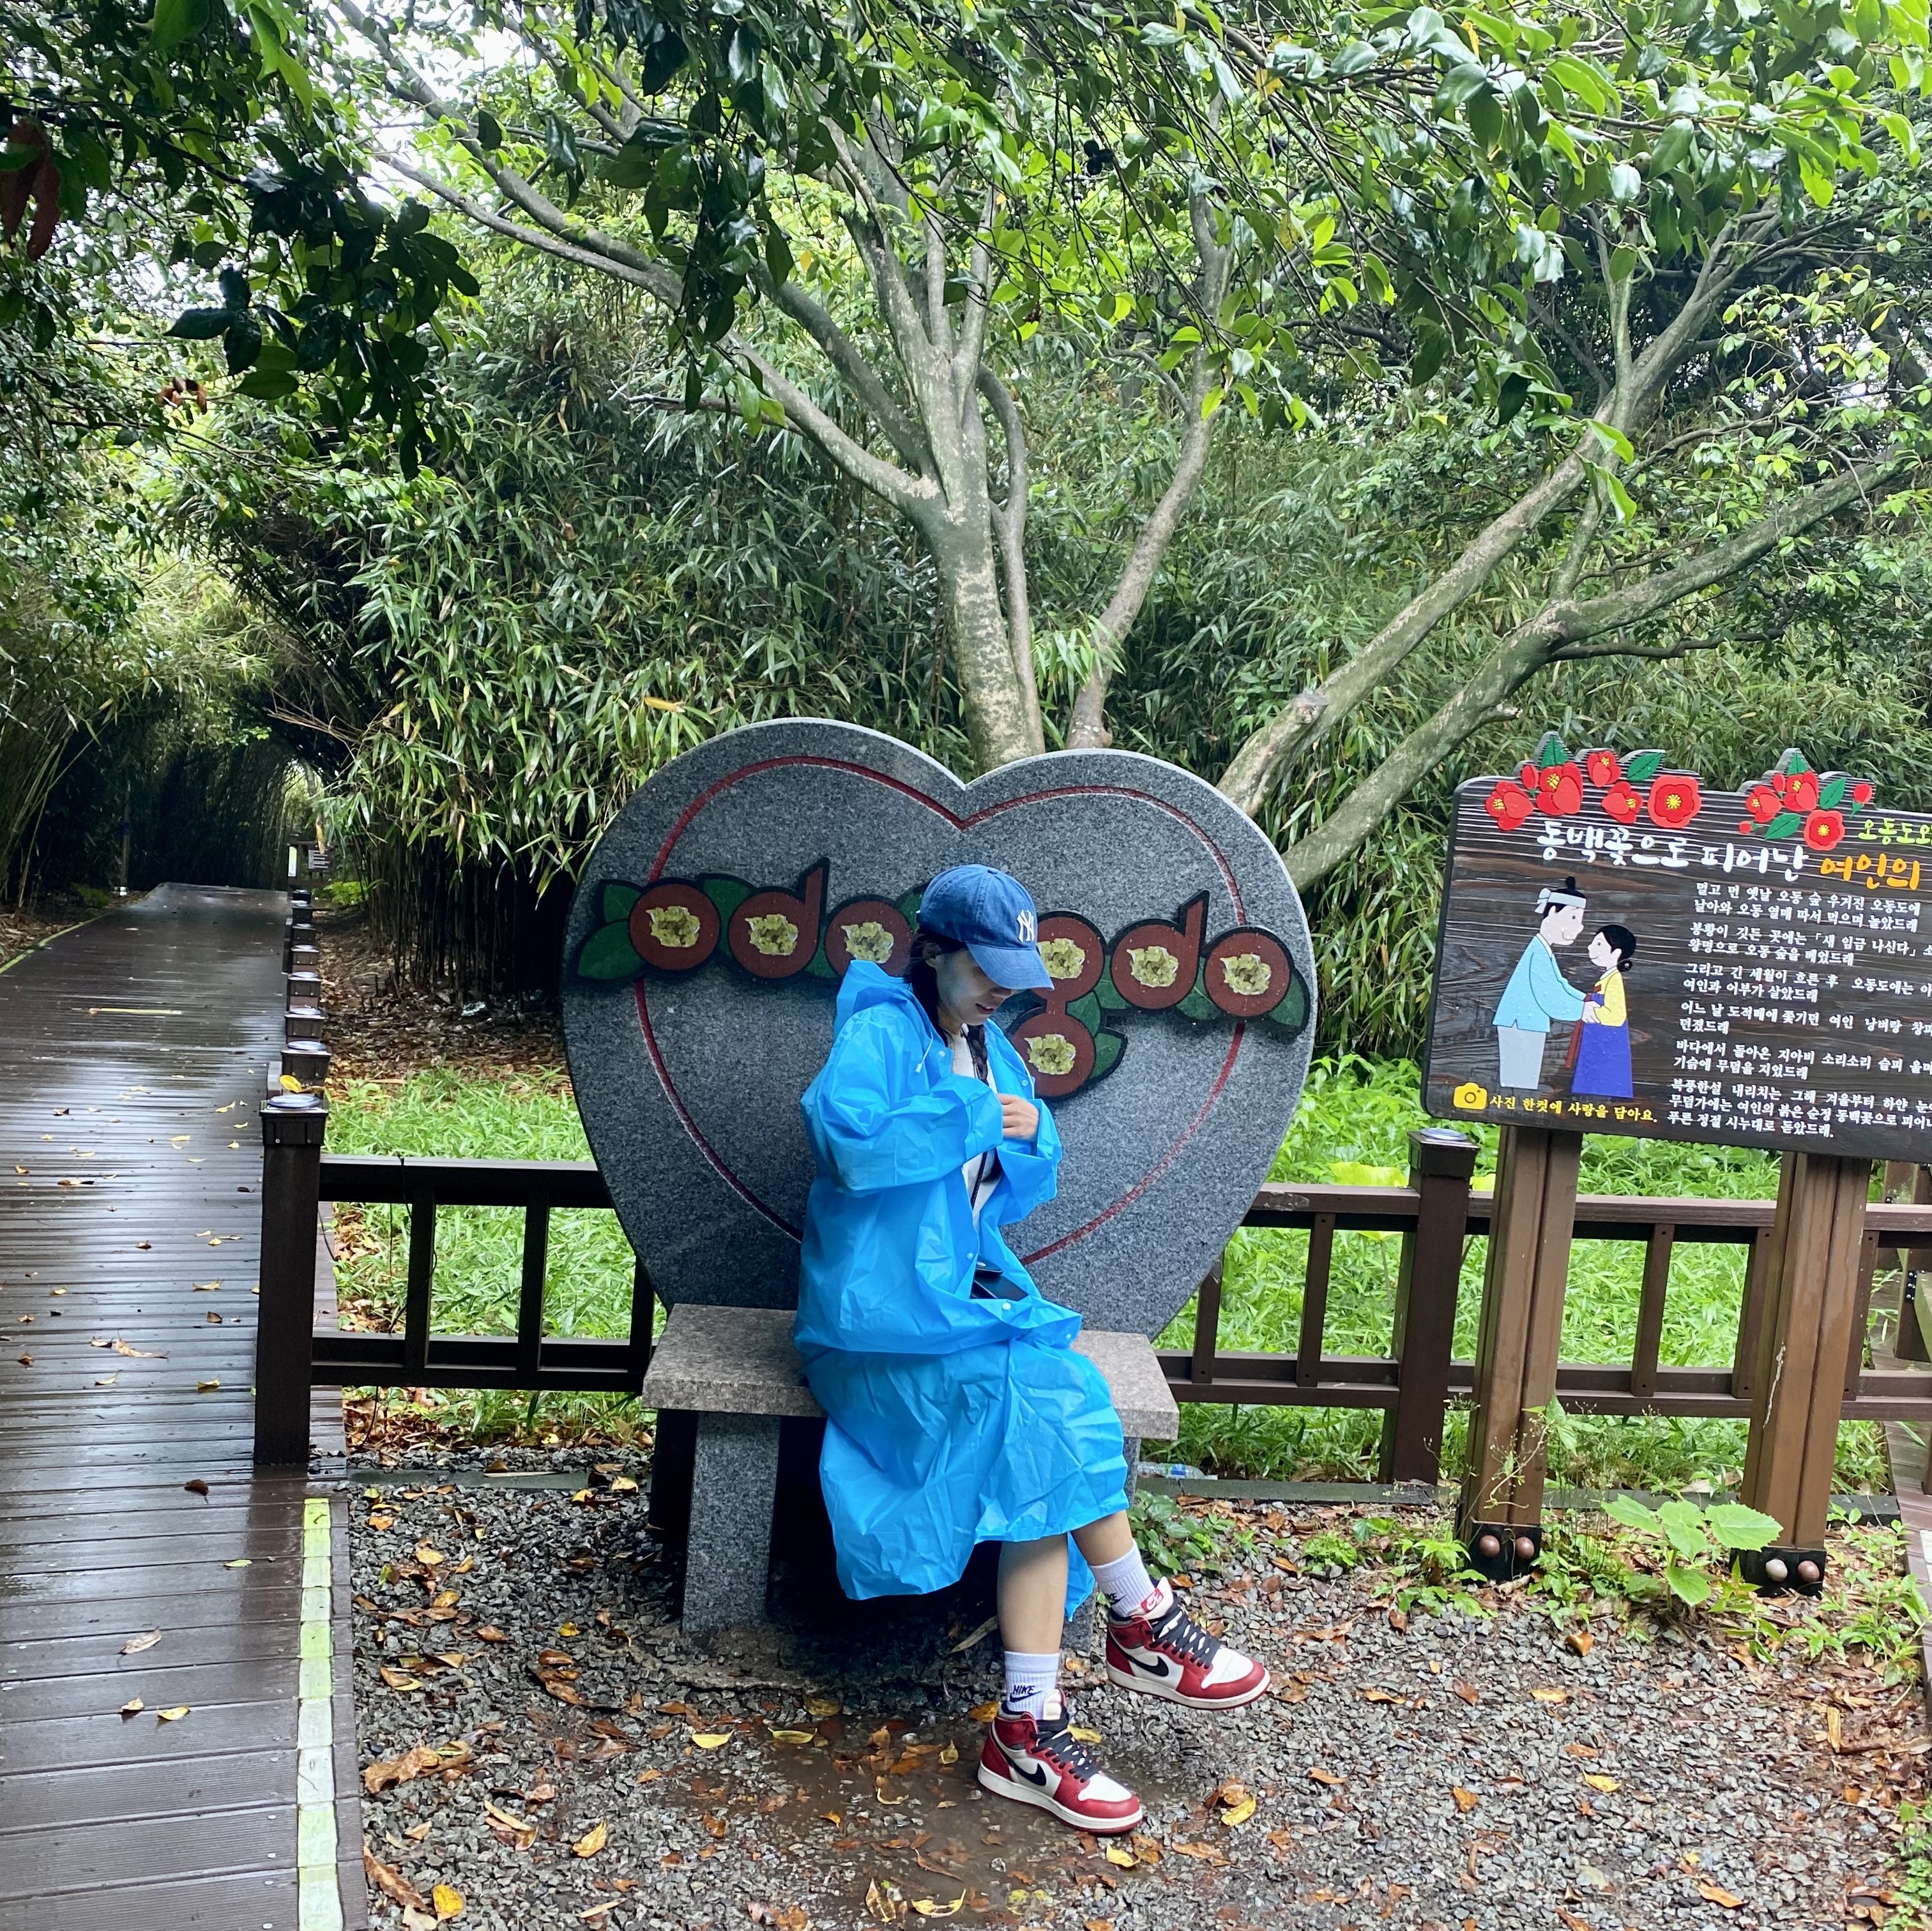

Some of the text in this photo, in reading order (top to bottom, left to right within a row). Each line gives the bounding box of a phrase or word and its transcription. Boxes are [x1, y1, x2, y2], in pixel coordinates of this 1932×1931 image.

[1536, 820, 1921, 891] 동백꽃으로 피어난 여인의
[1694, 898, 1733, 915] 날아와
[1797, 907, 1822, 924] 따서
[1827, 911, 1864, 928] 먹으며
[1868, 915, 1918, 933] 놀았드래
[1696, 882, 1721, 896] 멀고
[1728, 884, 1740, 898] 먼
[1746, 886, 1772, 902] 옛날
[1827, 894, 1865, 911] 우거진
[1870, 899, 1921, 916] 오동도에
[1017, 909, 1035, 943] NY
[1690, 922, 1728, 938] 봉황이
[1737, 927, 1762, 941] 깃든
[1769, 929, 1807, 945] 곳에는
[1842, 936, 1866, 951] 임금
[1688, 938, 1738, 953] 왕명으로
[625, 857, 1292, 1098] odogdo
[1683, 978, 1818, 1003] 여인과 어부가 살았드래
[1685, 962, 1723, 976] 그리고
[1731, 966, 1743, 980] 긴
[1749, 967, 1787, 983] 세월이
[1793, 971, 1820, 987] 흐른
[1825, 974, 1839, 988] 후
[1852, 977, 1915, 996] 오동도에는
[1679, 1017, 1730, 1034] 던졌드래
[1681, 1000, 1706, 1014] 어느
[1711, 1003, 1724, 1017] 날
[1829, 1014, 1854, 1029] 여인
[1864, 1017, 1903, 1034] 낭벼랑
[1673, 1056, 1808, 1080] 기슭에 무덤을 지었드래
[1677, 1039, 1726, 1057] 바다에서
[1733, 1044, 1772, 1060] 돌아온
[1778, 1049, 1815, 1064] 지아비
[1822, 1052, 1871, 1070] 소리소리
[1878, 1057, 1903, 1072] 슬피
[1489, 1094, 1658, 1123] 사진 한컷에 사랑을 담아요.
[1669, 1094, 1733, 1112] 무덤가에는
[1737, 1100, 1774, 1116] 여인의
[1778, 1103, 1804, 1119] 붉은
[1807, 1107, 1832, 1121] 순정
[1836, 1109, 1898, 1126] 동백꽃으로
[1671, 1079, 1722, 1095] 북풍한설
[1731, 1084, 1782, 1101] 내리치는
[1825, 1091, 1875, 1109] 겨울부터
[1883, 1096, 1908, 1112] 하얀
[1668, 1110, 1693, 1125] 푸른
[1697, 1113, 1722, 1128] 정절
[1726, 1116, 1776, 1132] 시누대로
